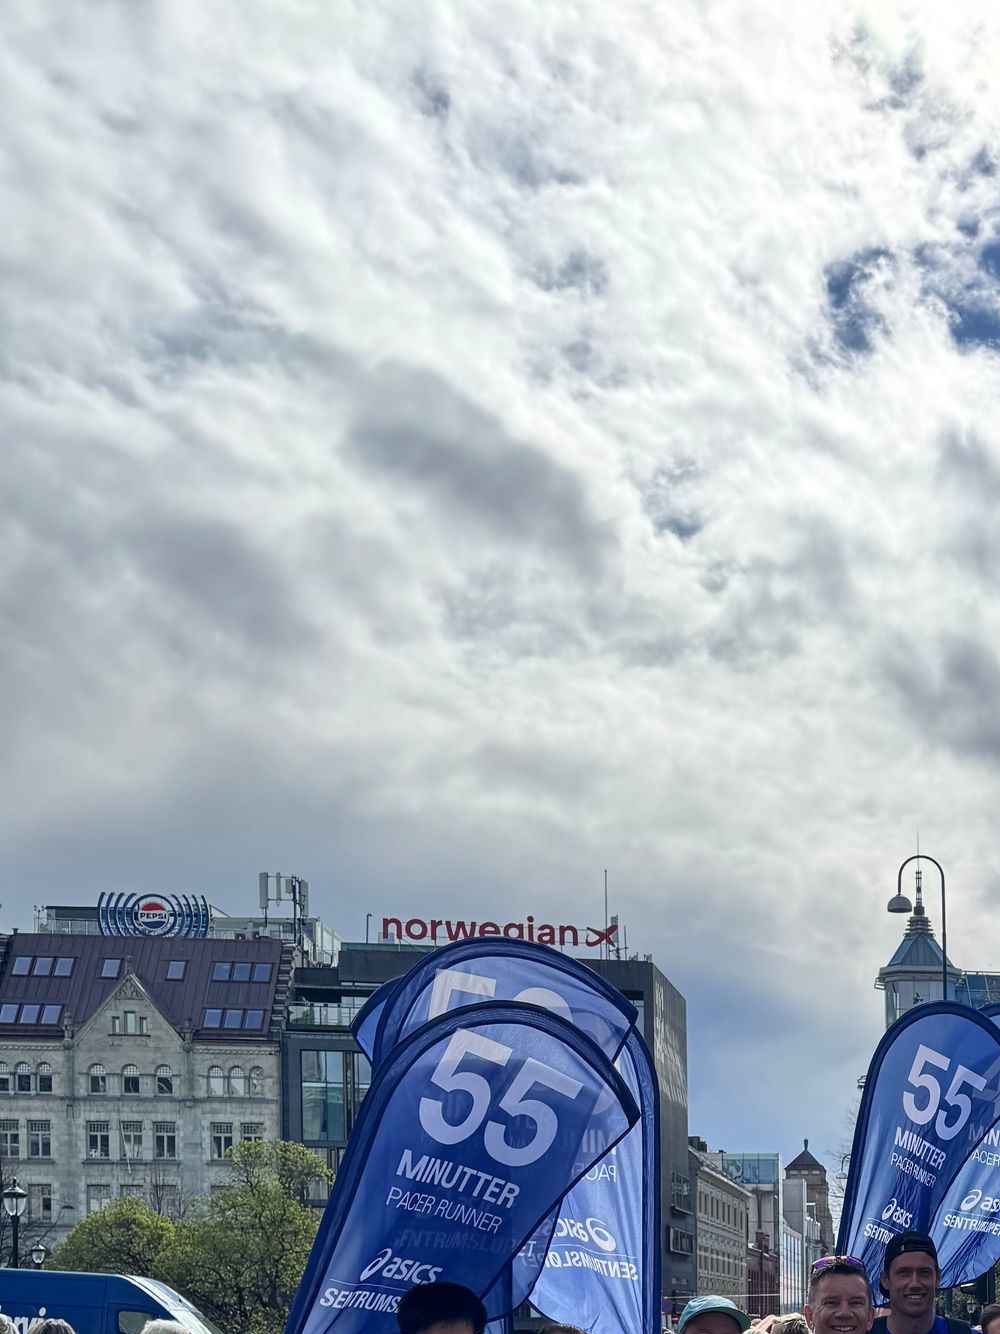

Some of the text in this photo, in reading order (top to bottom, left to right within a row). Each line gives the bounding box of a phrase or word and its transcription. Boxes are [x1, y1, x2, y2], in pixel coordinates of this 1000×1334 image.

[140, 912, 167, 920] PEPSI
[382, 915, 579, 947] norwegian
[419, 1028, 584, 1167] 55
[902, 1043, 988, 1141] 55
[894, 1126, 947, 1170] MINUTTER
[396, 1148, 520, 1209] MINUTTER
[891, 1152, 937, 1189] PACER RUNNER
[386, 1187, 503, 1234] PACER RUNNER
[319, 1287, 401, 1314] SENTRUMS
